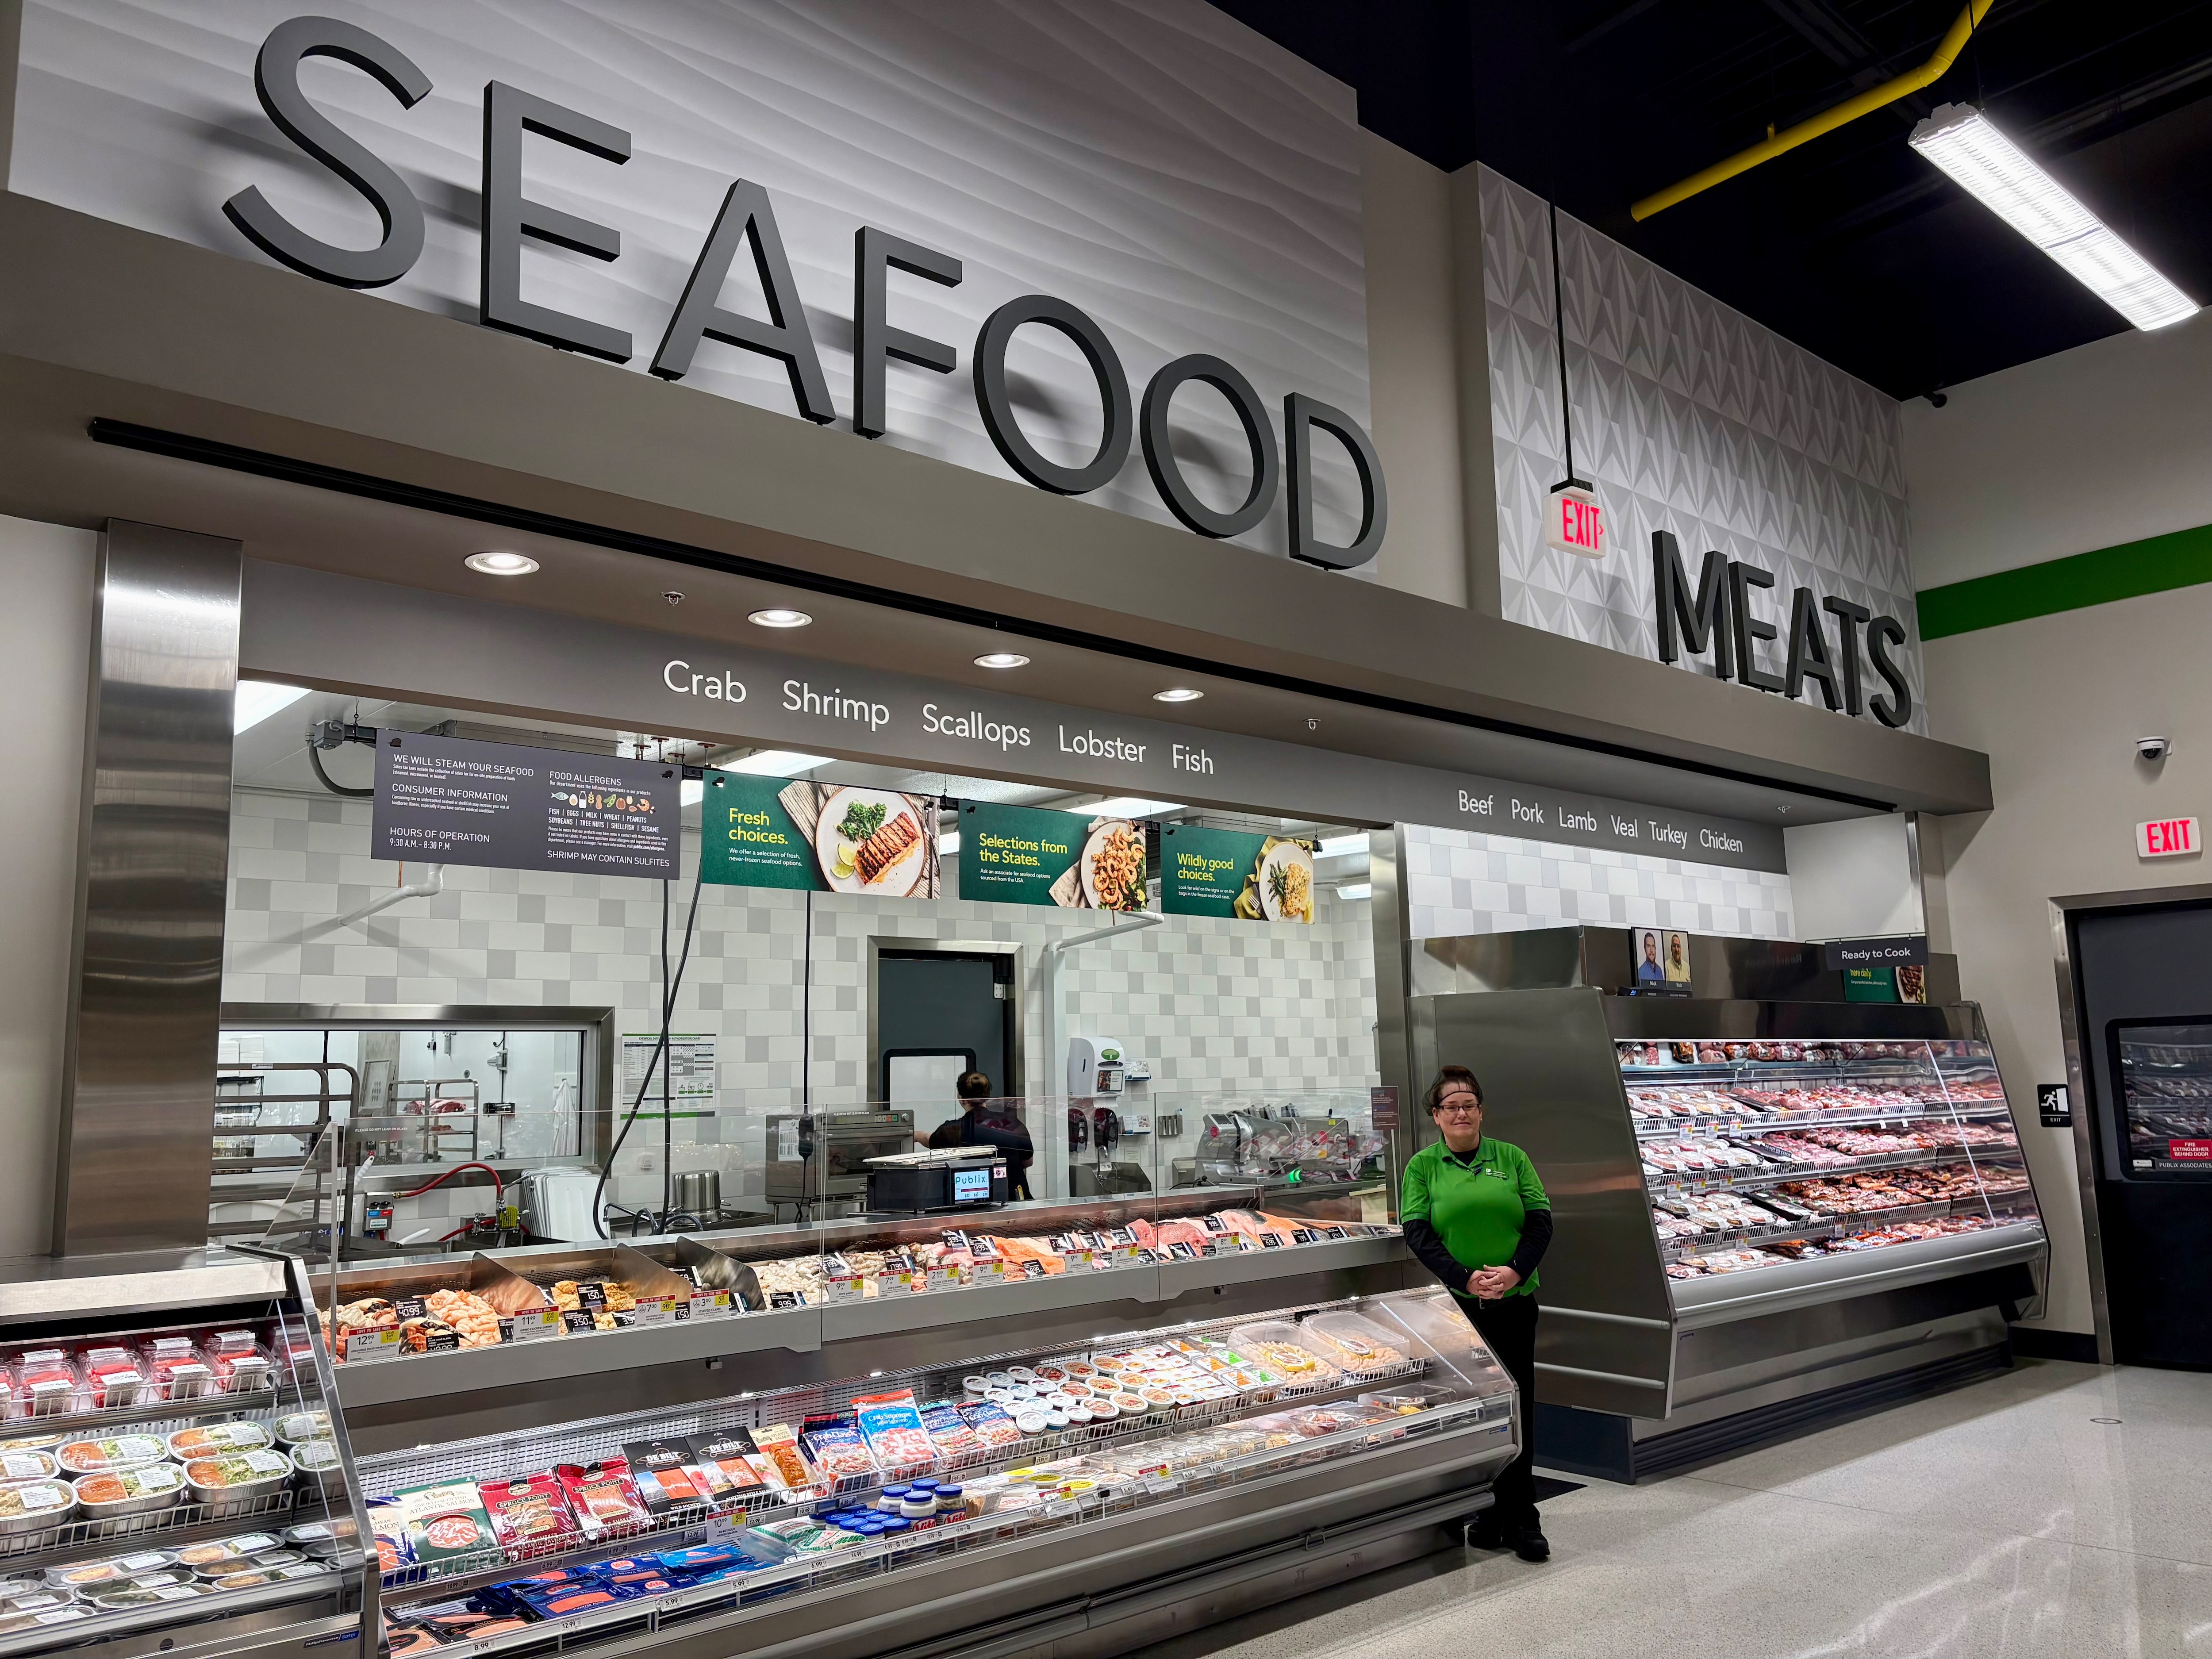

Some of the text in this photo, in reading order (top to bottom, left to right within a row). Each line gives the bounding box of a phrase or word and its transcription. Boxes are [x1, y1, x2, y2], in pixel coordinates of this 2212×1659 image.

[221, 15, 1388, 572] SEAFOOD
[1562, 498, 1600, 550] EXIT
[1652, 530, 1911, 727] MEATS
[663, 659, 1214, 776] Crab Shrimp Scallops Lobster Fish
[394, 754, 534, 776] WE WILL STEAM YOUR SEAFOOD
[550, 771, 622, 786] FOOD ALLERGENS
[392, 783, 508, 802] CONSUMER INFORMATION
[548, 817, 573, 826] SOYBEANS
[729, 807, 769, 826] Fresh
[1458, 790, 1743, 853] Beef Pork Lamb Veal Turkey Chicken
[390, 827, 422, 837] HOURS
[439, 831, 490, 842] OPERATION
[729, 826, 788, 845] choices.
[2147, 820, 2190, 853] EXIT
[390, 838, 403, 847] 9:30
[424, 841, 437, 849] 8:30
[438, 842, 452, 850] P.M.
[979, 833, 1068, 854] Selections from
[547, 850, 669, 867] SHRIMP MAY CONTAIN SULFITES
[979, 849, 1040, 866] the States.
[1177, 853, 1233, 872] Wildly good
[1178, 868, 1215, 882] choices.
[1842, 949, 1870, 960] Ready
[1885, 947, 1911, 957] Cook
[1850, 968, 1860, 977] here
[813, 1432, 832, 1441] Crab
[723, 1441, 741, 1450] BILT
[575, 1482, 600, 1493] SPRUCE
[410, 1498, 475, 1515] ATLANTIC SALMON
[499, 1498, 527, 1508] SPRUCE
[811, 1560, 822, 1569] 6.99
